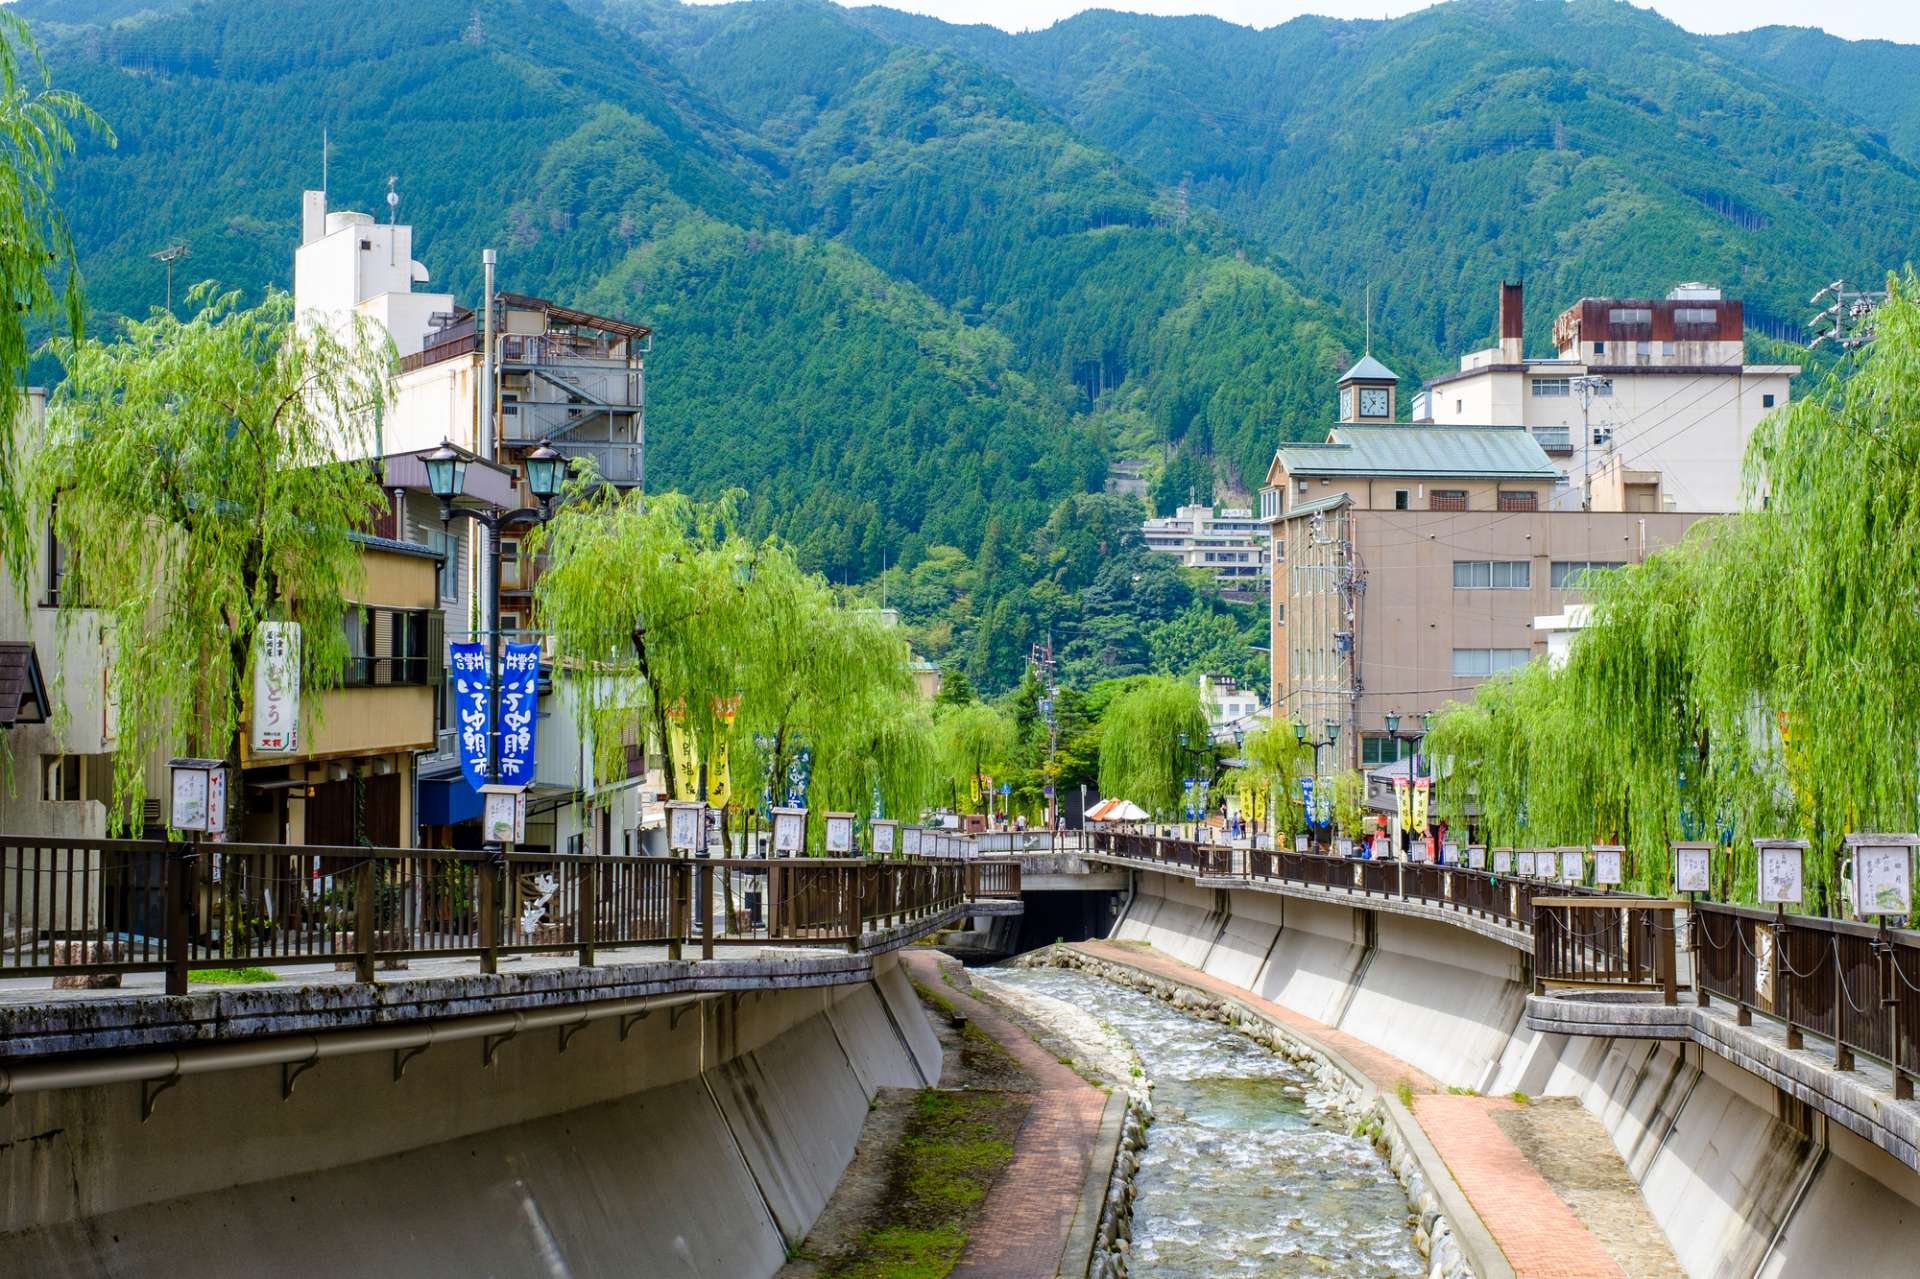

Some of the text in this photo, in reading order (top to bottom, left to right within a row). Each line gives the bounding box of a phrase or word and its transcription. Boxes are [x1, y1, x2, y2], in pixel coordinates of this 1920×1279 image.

[457, 678, 488, 776] いでゆ朝市
